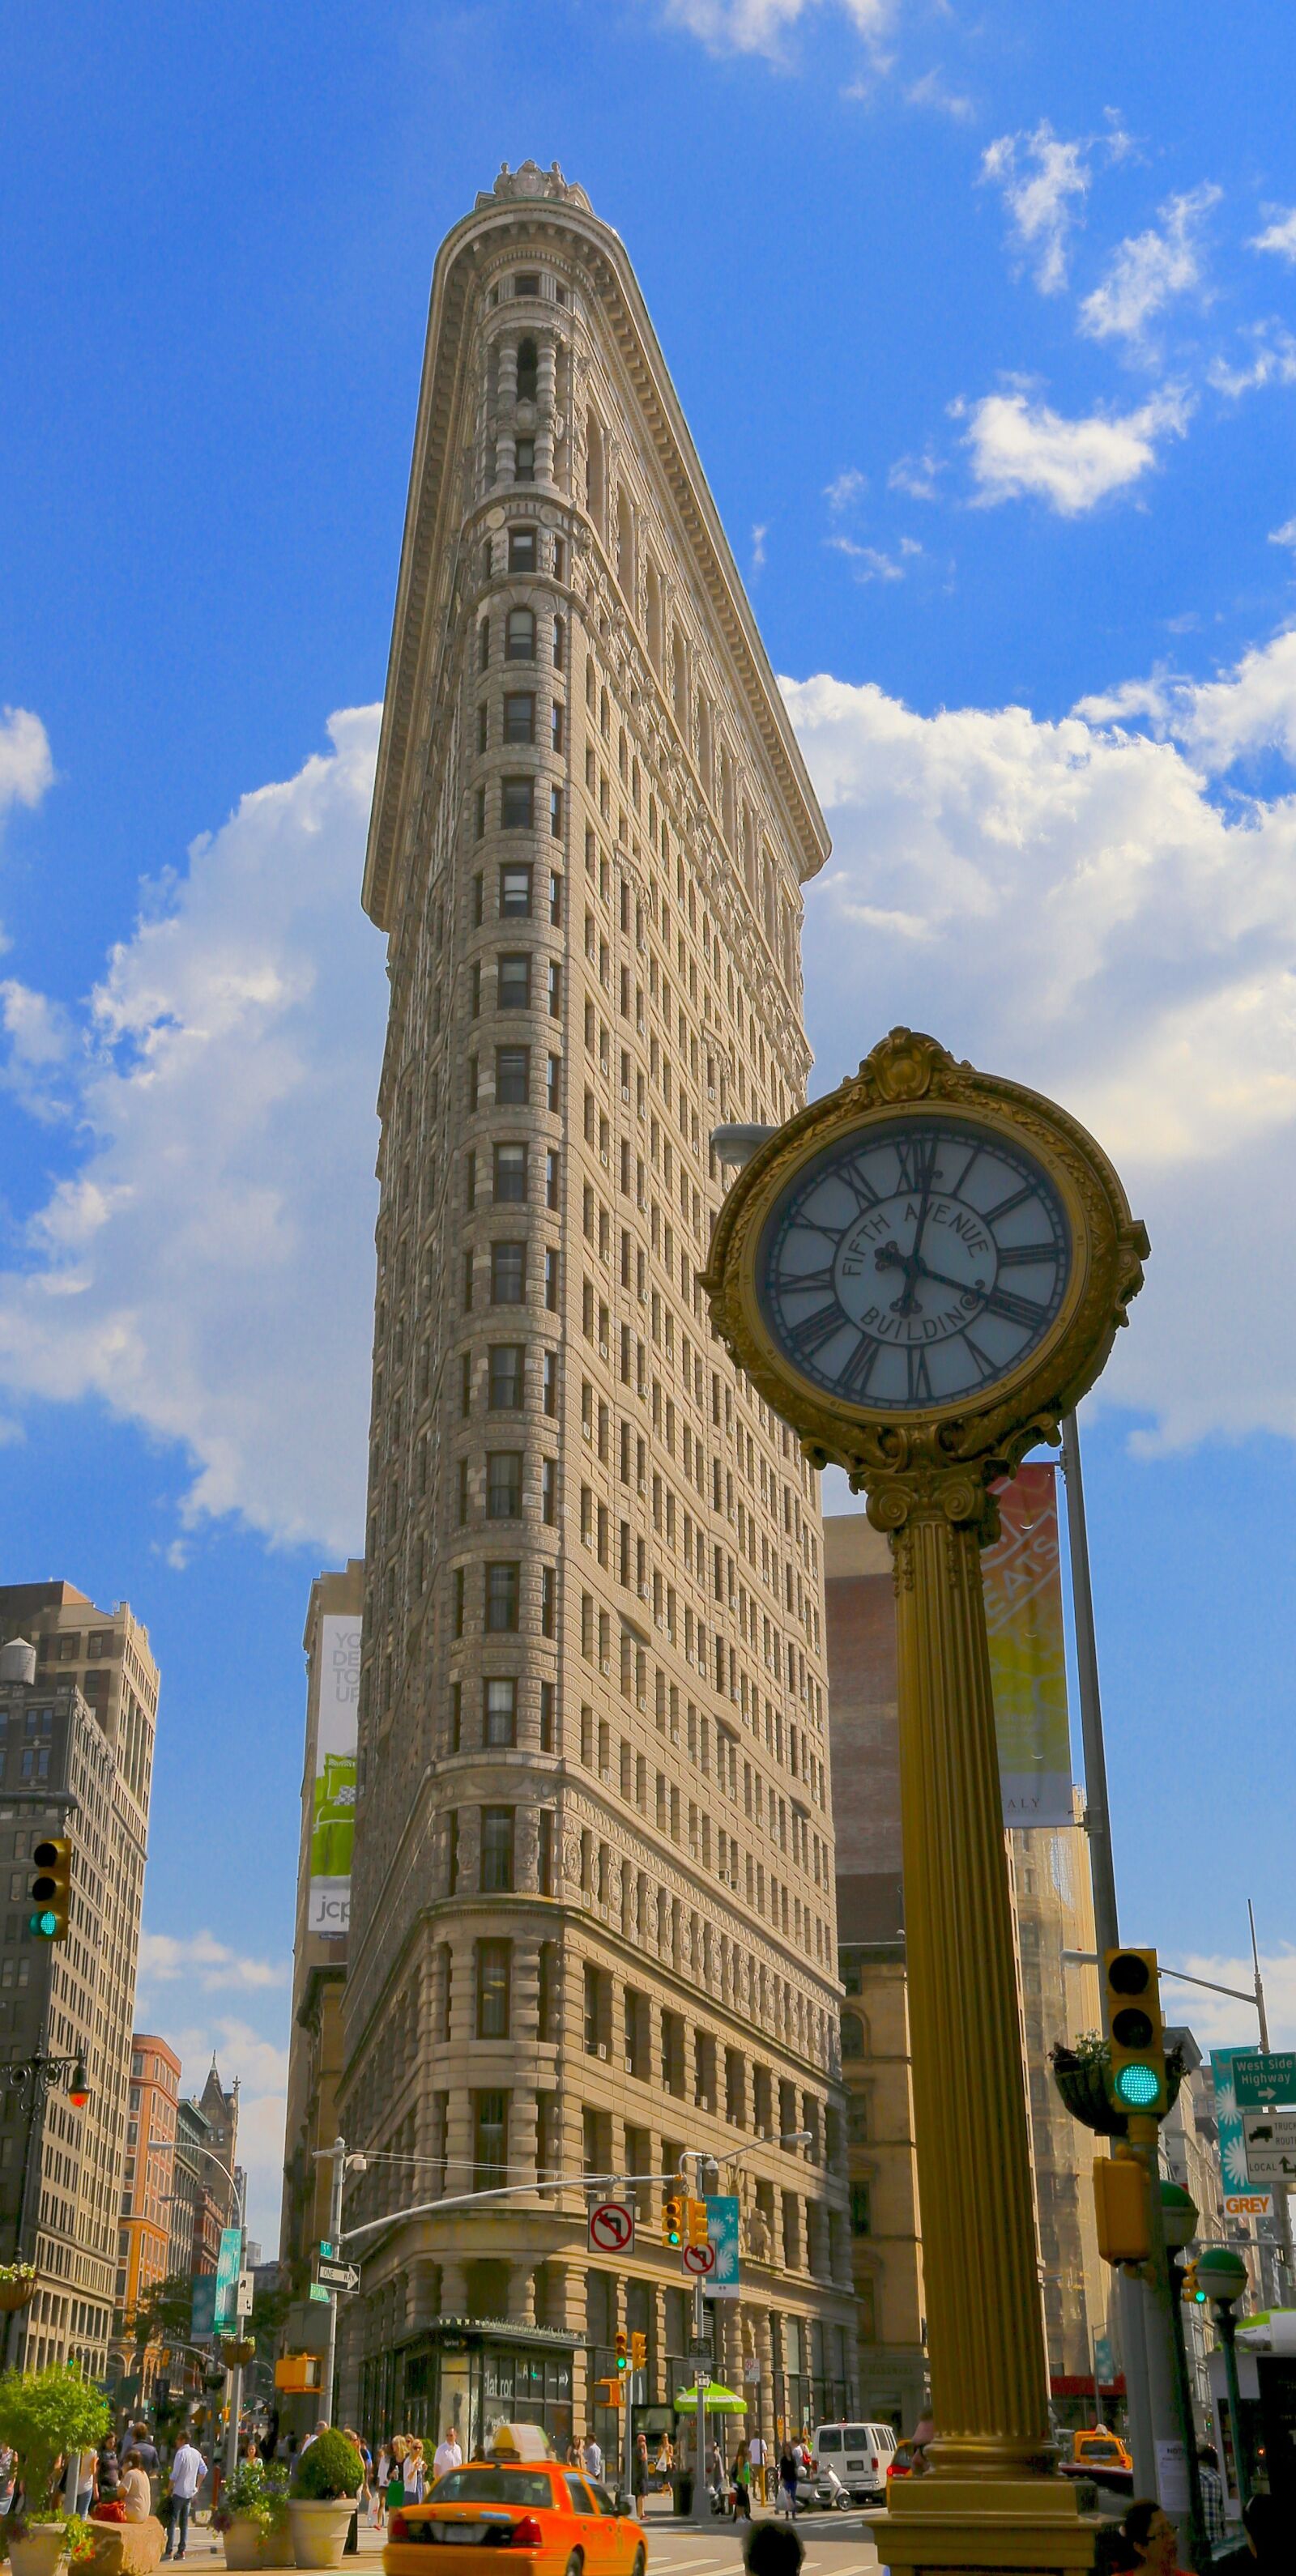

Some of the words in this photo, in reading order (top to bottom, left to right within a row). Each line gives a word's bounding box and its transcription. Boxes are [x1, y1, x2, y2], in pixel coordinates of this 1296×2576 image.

[842, 1214, 890, 1276] FIFTH
[904, 1202, 989, 1258] AVENUE
[860, 1292, 980, 1341] BUILDING
[982, 1535, 1059, 1617] EATS
[316, 1896, 350, 1922] jcp
[1237, 2060, 1264, 2071] West
[1268, 2058, 1293, 2070] Side
[1242, 2072, 1290, 2087] Highway
[1249, 2163, 1277, 2171] LOCAL
[1226, 2196, 1269, 2214] GREY
[323, 2268, 334, 2279] ONE
[343, 2272, 355, 2282] WAY
